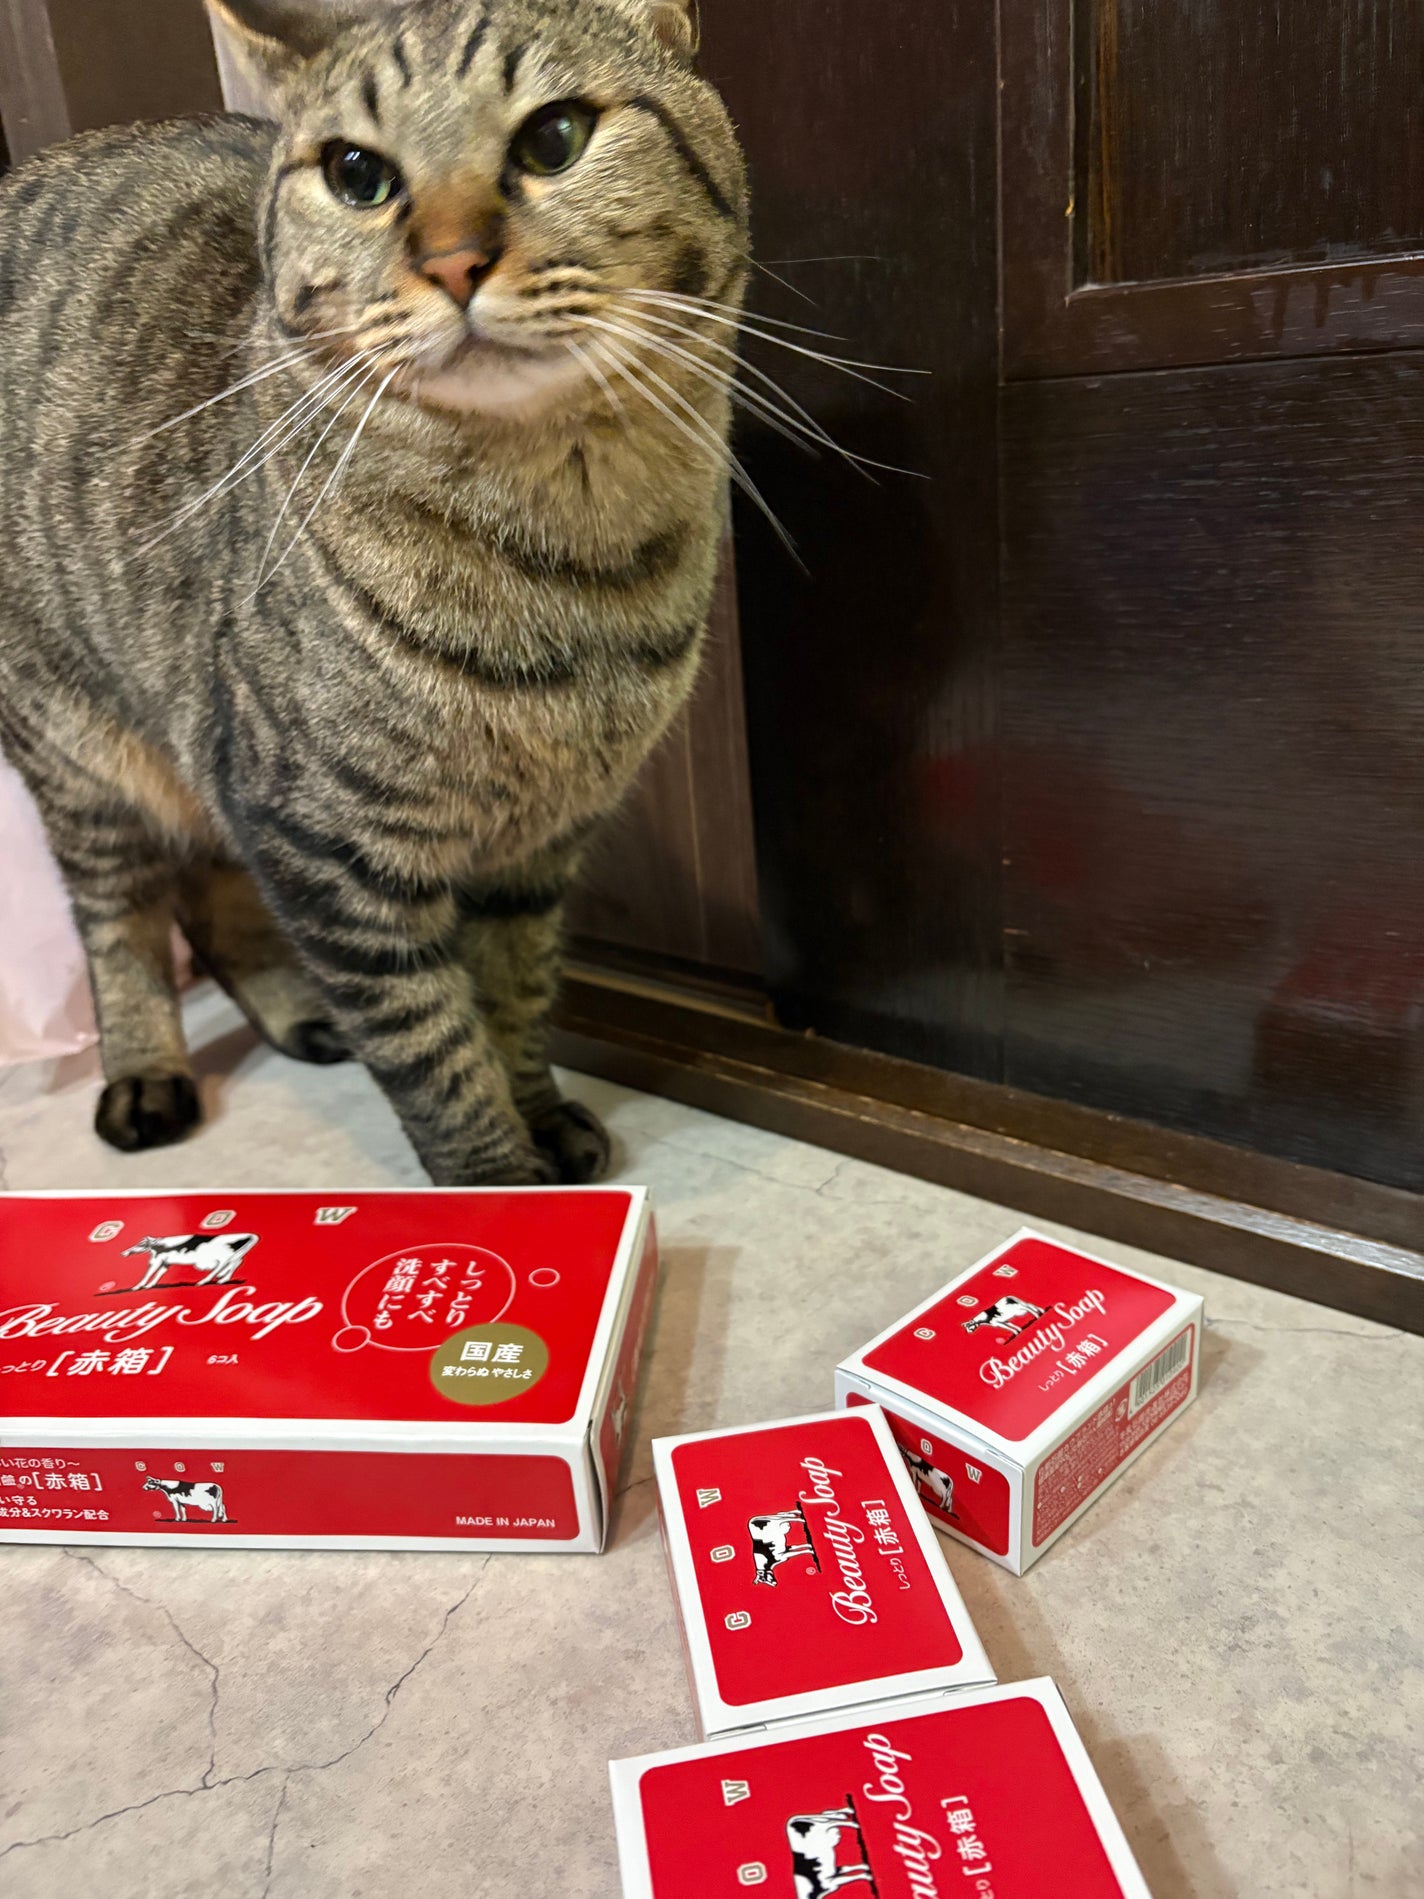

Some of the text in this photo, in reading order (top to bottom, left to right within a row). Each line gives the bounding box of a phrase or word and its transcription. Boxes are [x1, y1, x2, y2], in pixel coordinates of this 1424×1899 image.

[0, 1285, 324, 1343] Beauty Soap
[373, 1258, 422, 1330] 洗顔にも
[407, 1259, 457, 1323] すべすべ
[445, 1261, 486, 1327] しっとり
[206, 1353, 239, 1365] 6コ入
[460, 1341, 524, 1363] 国産
[980, 1289, 1107, 1389] Beauty Soap
[455, 1516, 556, 1528] MADE IN JAPAN
[798, 1456, 878, 1625] Beauty Soap
[863, 1733, 912, 1821] Soap
